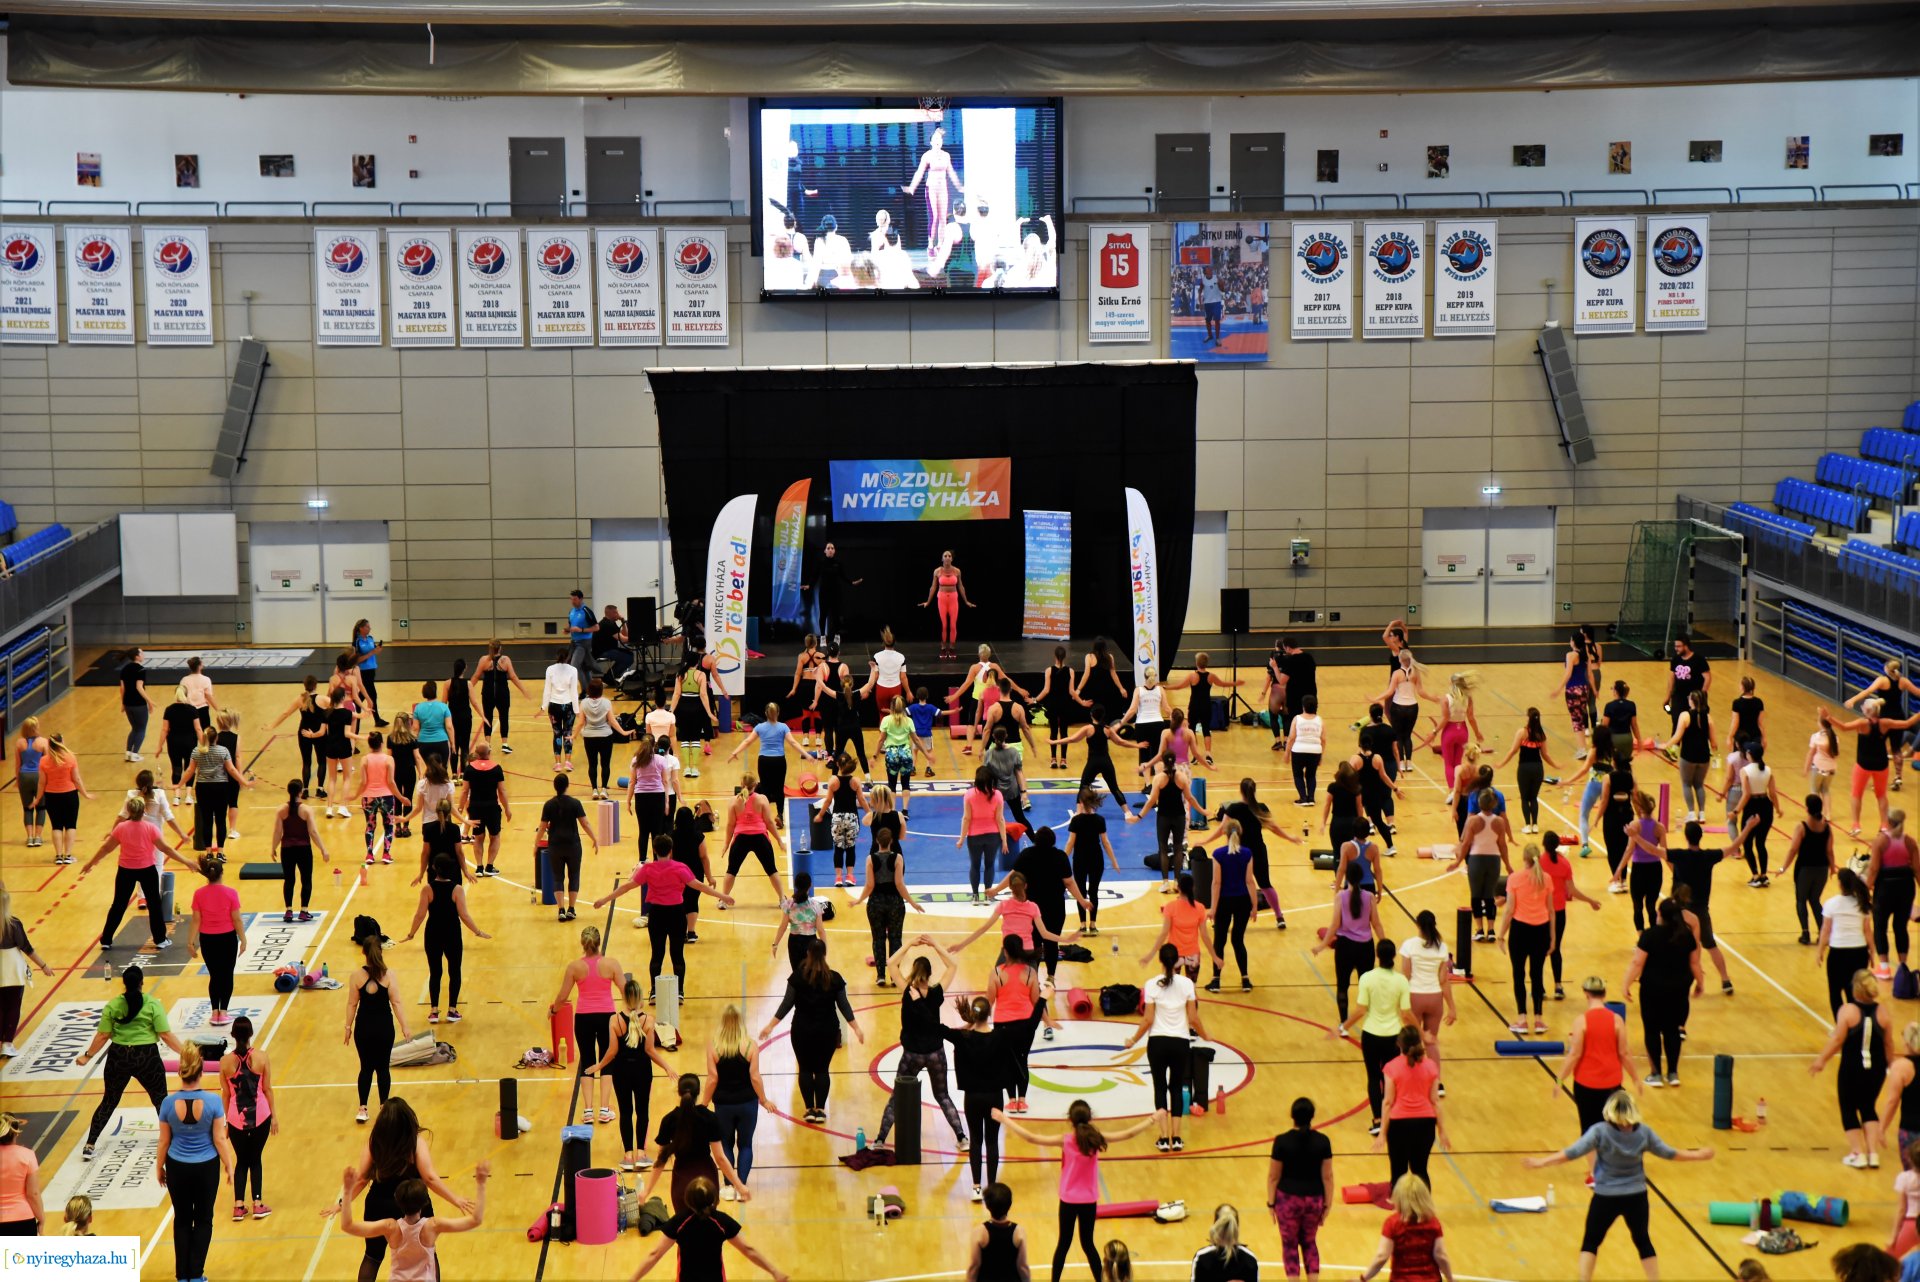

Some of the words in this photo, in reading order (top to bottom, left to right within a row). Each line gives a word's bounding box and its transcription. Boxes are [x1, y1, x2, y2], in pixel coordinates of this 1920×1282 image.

[1202, 230, 1222, 240] SITKU
[1297, 233, 1316, 257] BLUE
[1319, 233, 1348, 259] SHARKS
[1369, 233, 1388, 257] BLUE
[1391, 232, 1419, 259] SHARKS
[1441, 231, 1460, 256] BLUE
[1463, 230, 1492, 257] SHARKS
[1110, 254, 1129, 276] 15
[15, 297, 31, 305] 2021
[92, 298, 108, 306] 2021
[170, 299, 187, 307] 2020
[483, 300, 499, 308] 2018
[689, 300, 705, 308] 2017
[1098, 297, 1118, 305] Sitku
[1122, 296, 1141, 305] Ernő
[1450, 311, 1490, 321] HELYEZÉS
[1589, 308, 1628, 319] HELYEZÉS
[1660, 307, 1699, 317] HELYEZÉS
[1118, 319, 1144, 327] válogatott
[1308, 314, 1347, 324] HELYEZÉS
[1380, 313, 1418, 323] HELYEZÉS
[7, 319, 49, 328] HELYEZÉS
[84, 320, 126, 329] HELYEZÉS
[164, 320, 206, 330] HELYEZÉS
[334, 320, 375, 330] HELYEZÉS
[406, 322, 447, 332] HELYEZÉS
[477, 322, 517, 331] HELYEZÉS
[545, 322, 586, 332] HELYEZÉS
[618, 320, 655, 330] HELYEZÉS
[685, 321, 722, 331] HELYEZÉS
[842, 489, 999, 508] NYÍREGYHÁZA
[730, 536, 747, 567] ad!
[714, 560, 726, 632] NYÍREGYHÁZA
[726, 570, 744, 633] Többet
